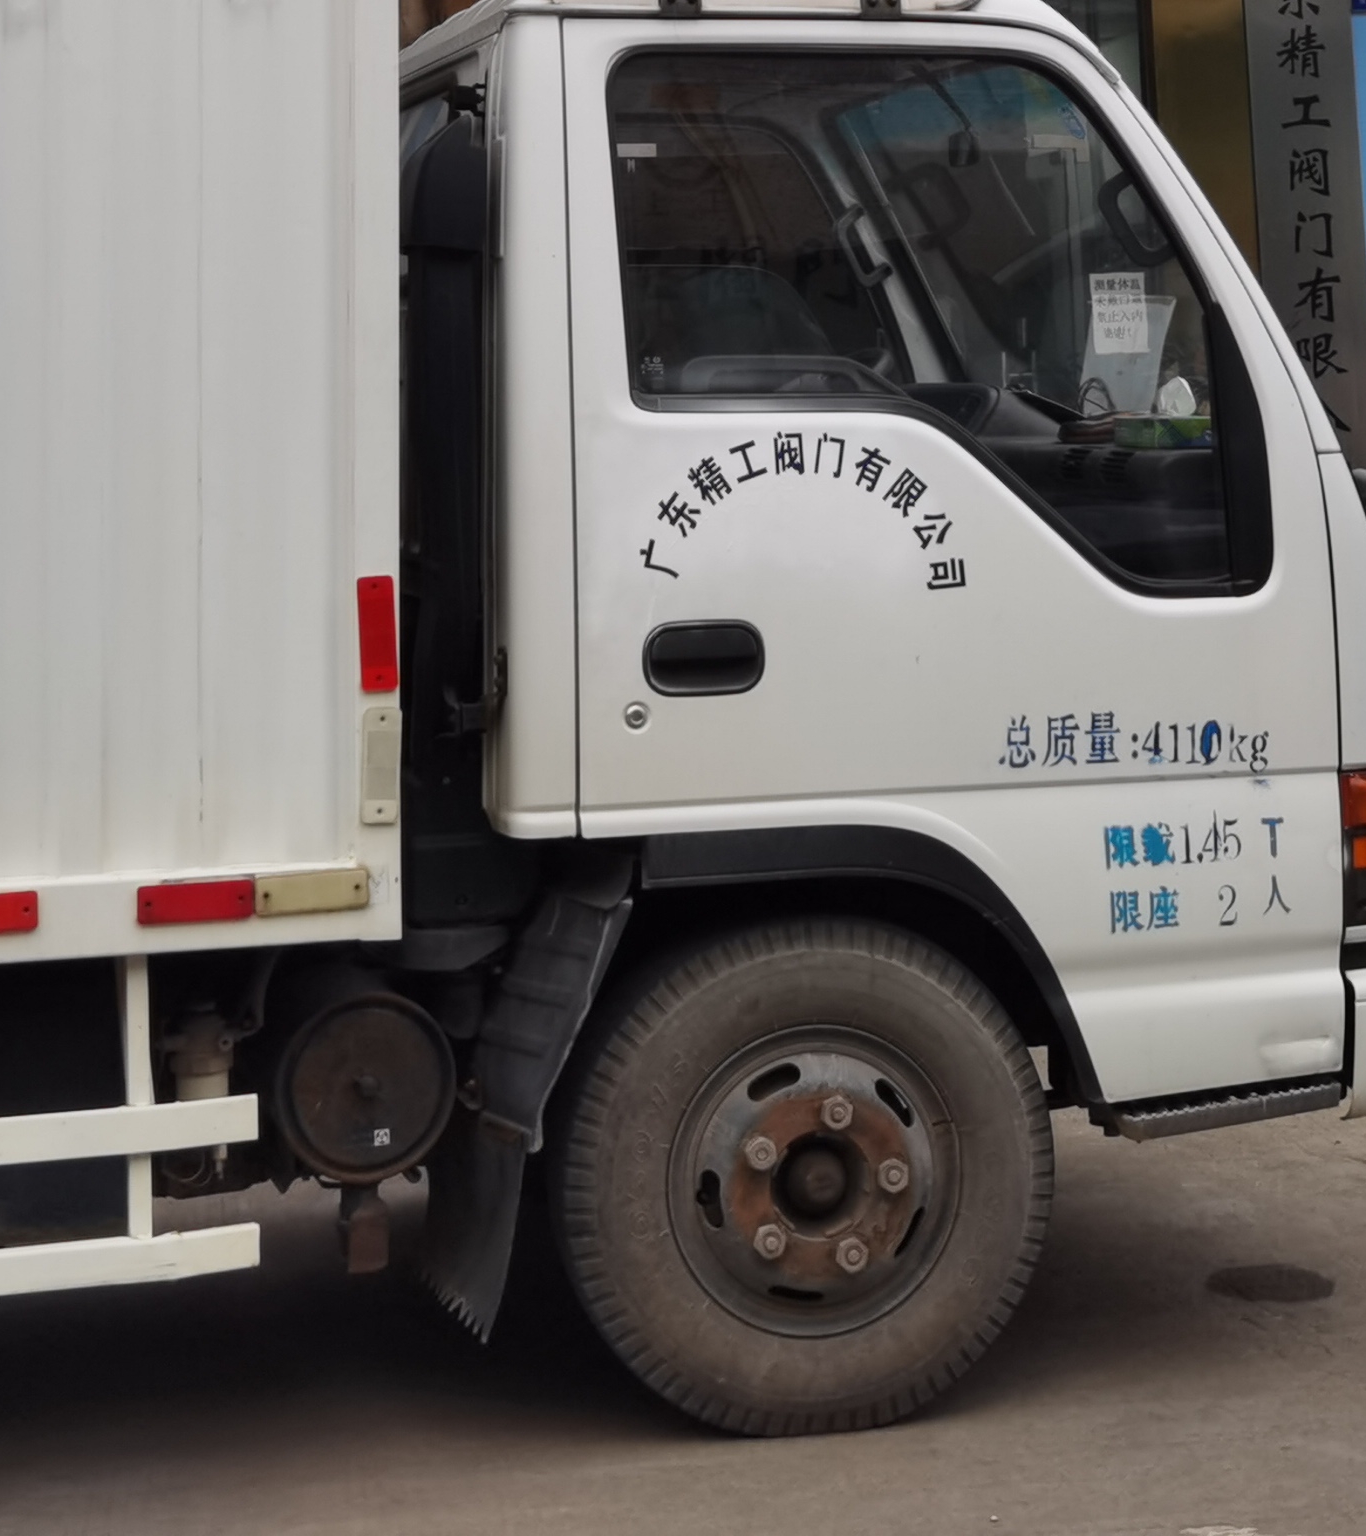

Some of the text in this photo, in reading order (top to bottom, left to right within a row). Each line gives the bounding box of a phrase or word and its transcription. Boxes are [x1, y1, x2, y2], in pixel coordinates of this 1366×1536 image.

[639, 431, 967, 591] 广东精工阀门有限公司
